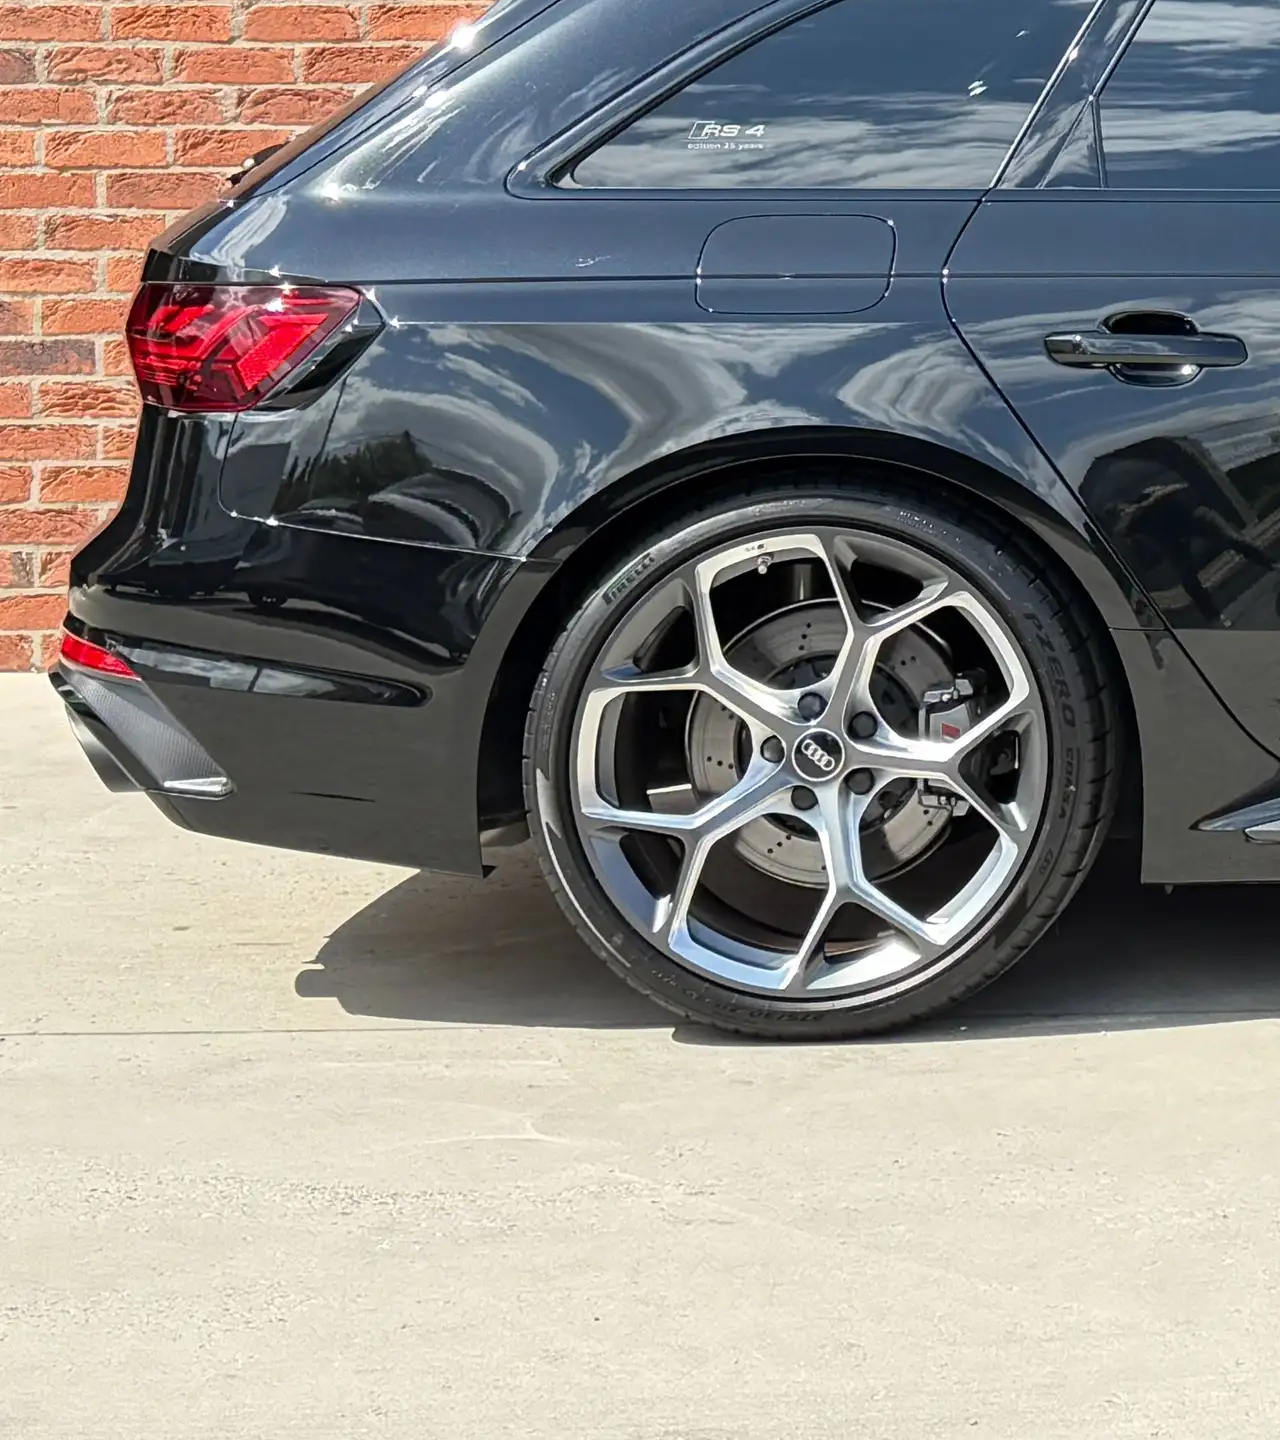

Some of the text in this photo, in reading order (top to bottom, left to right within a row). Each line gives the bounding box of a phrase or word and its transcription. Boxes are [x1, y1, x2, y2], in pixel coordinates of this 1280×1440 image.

[701, 124, 766, 137] RS 4
[688, 142, 764, 151] edition 25 years
